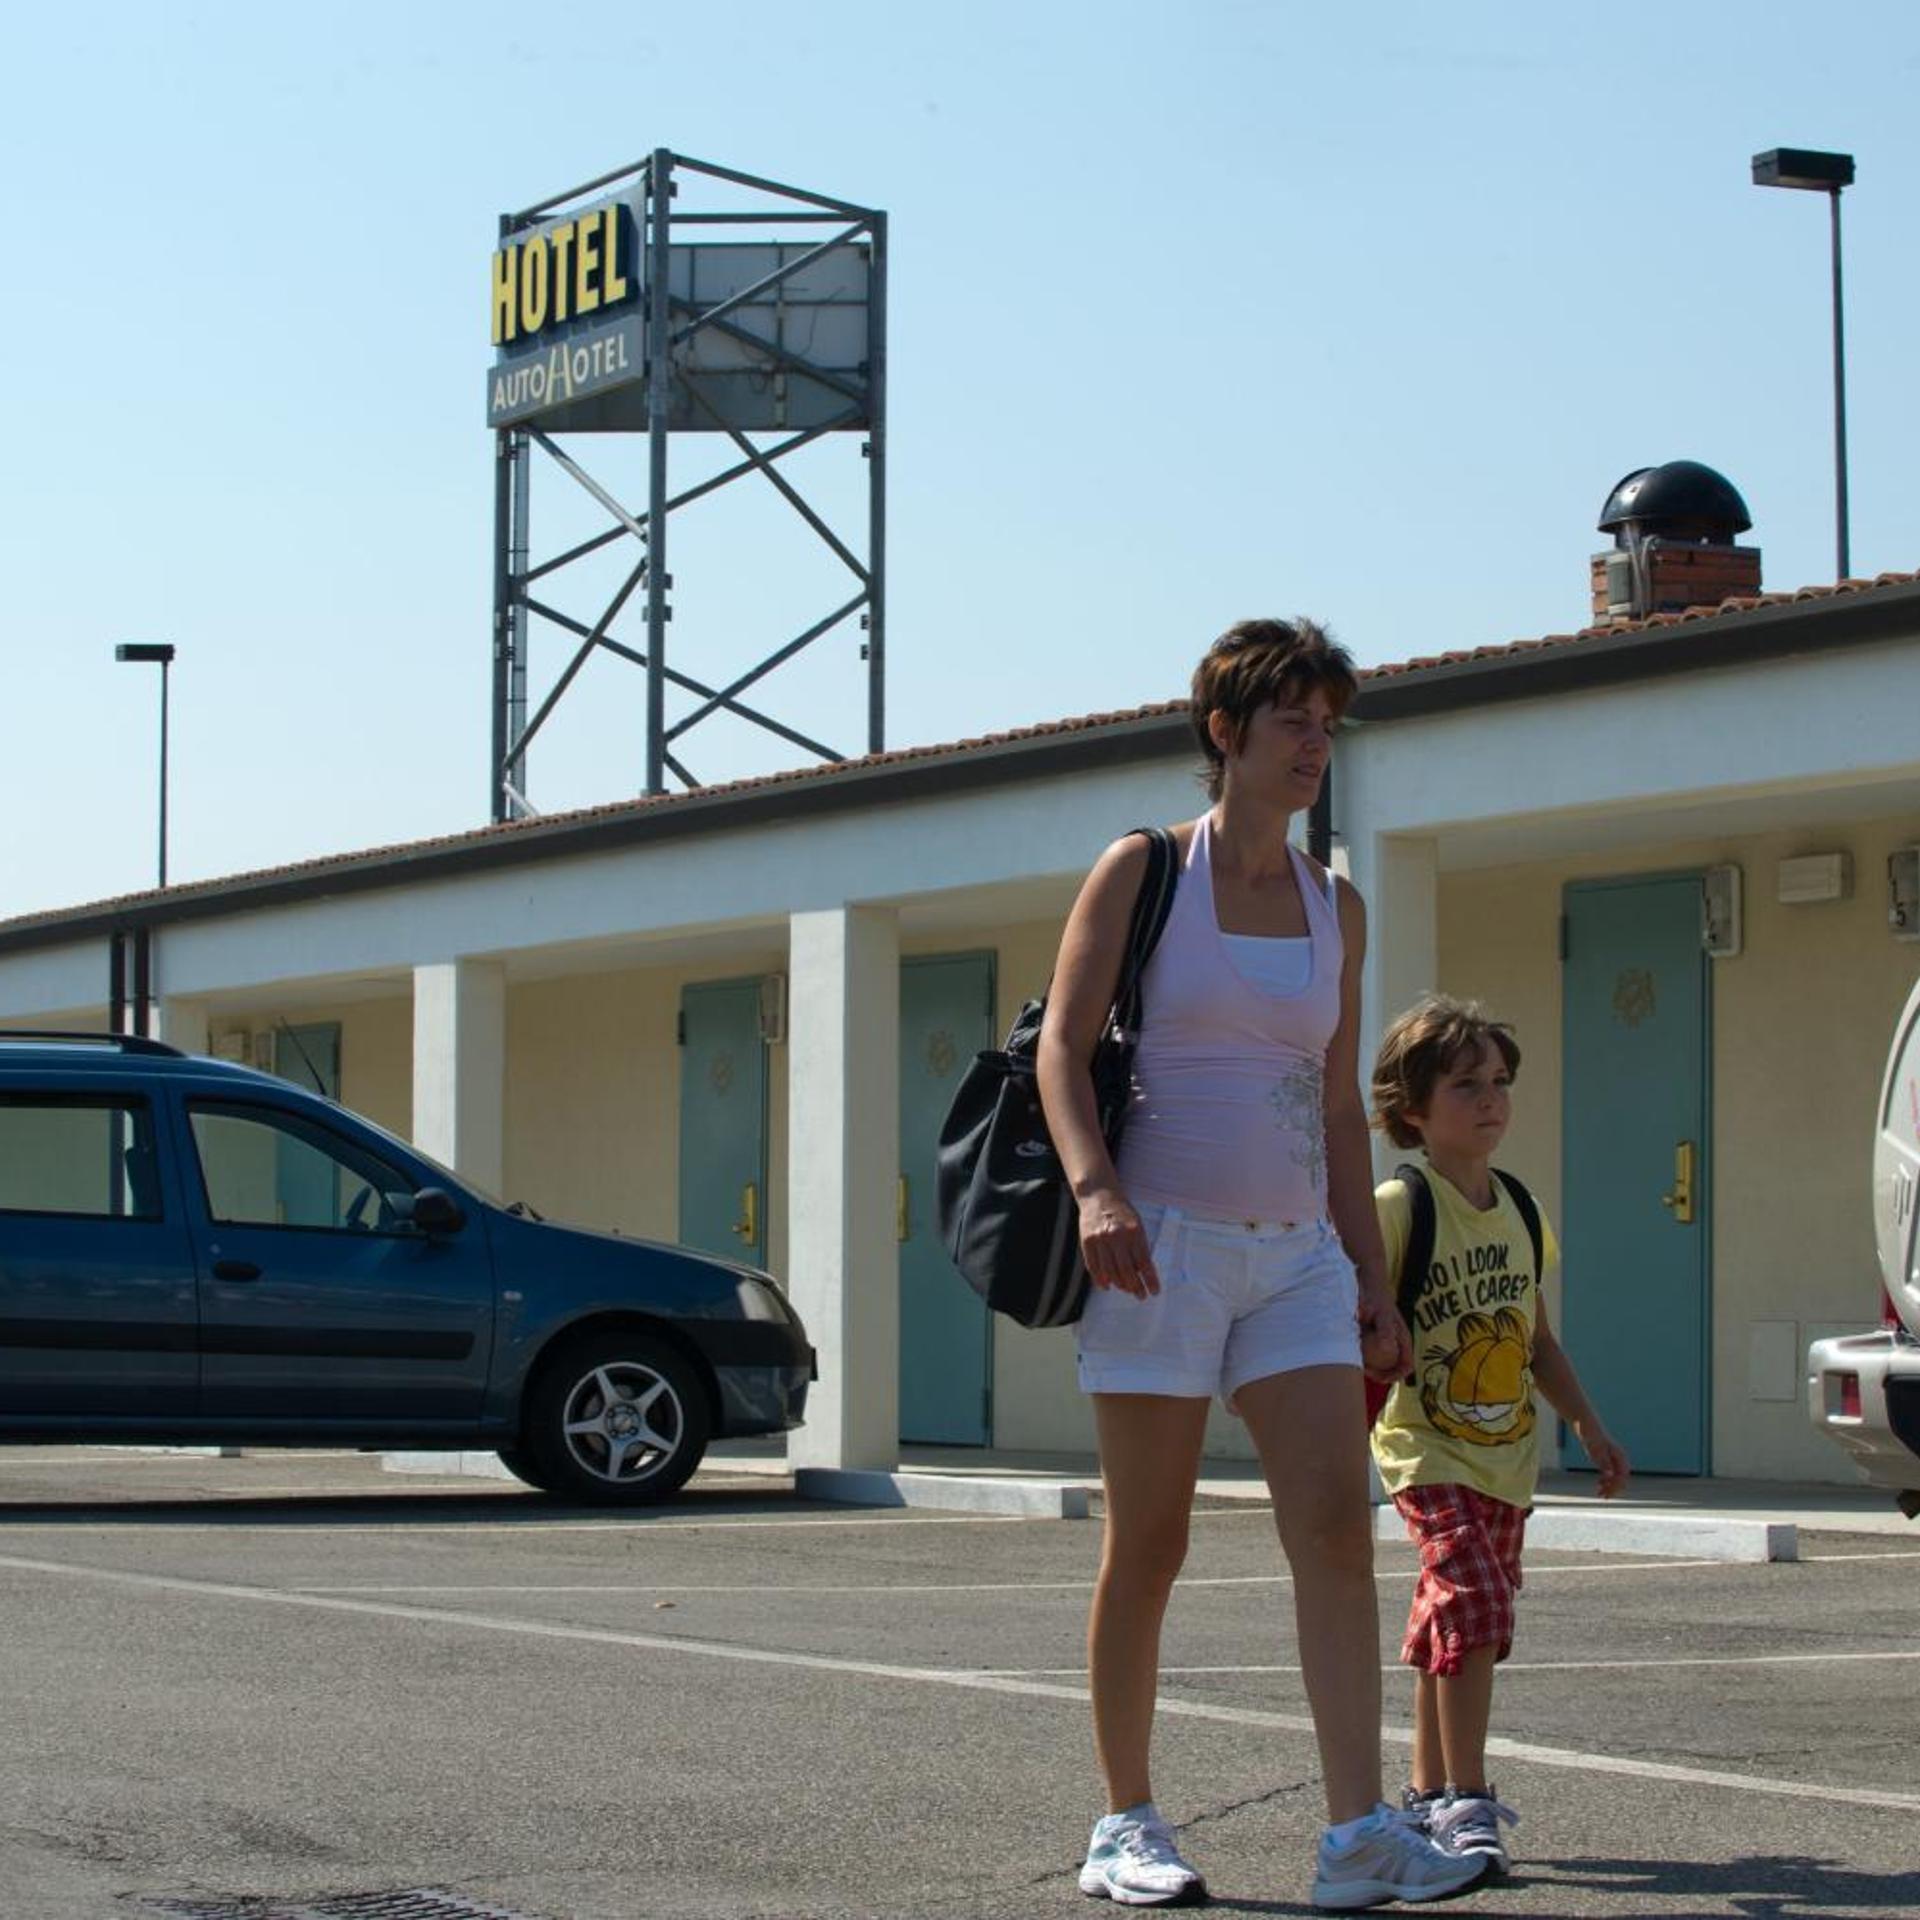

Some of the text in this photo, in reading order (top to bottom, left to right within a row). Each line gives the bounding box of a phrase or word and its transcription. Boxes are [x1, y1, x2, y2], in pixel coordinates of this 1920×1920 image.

[492, 204, 627, 346] HOTEL
[1451, 1255, 1461, 1282] I
[1466, 1244, 1508, 1277] LOOK
[1416, 1274, 1529, 1332] LIKE I CARE?
